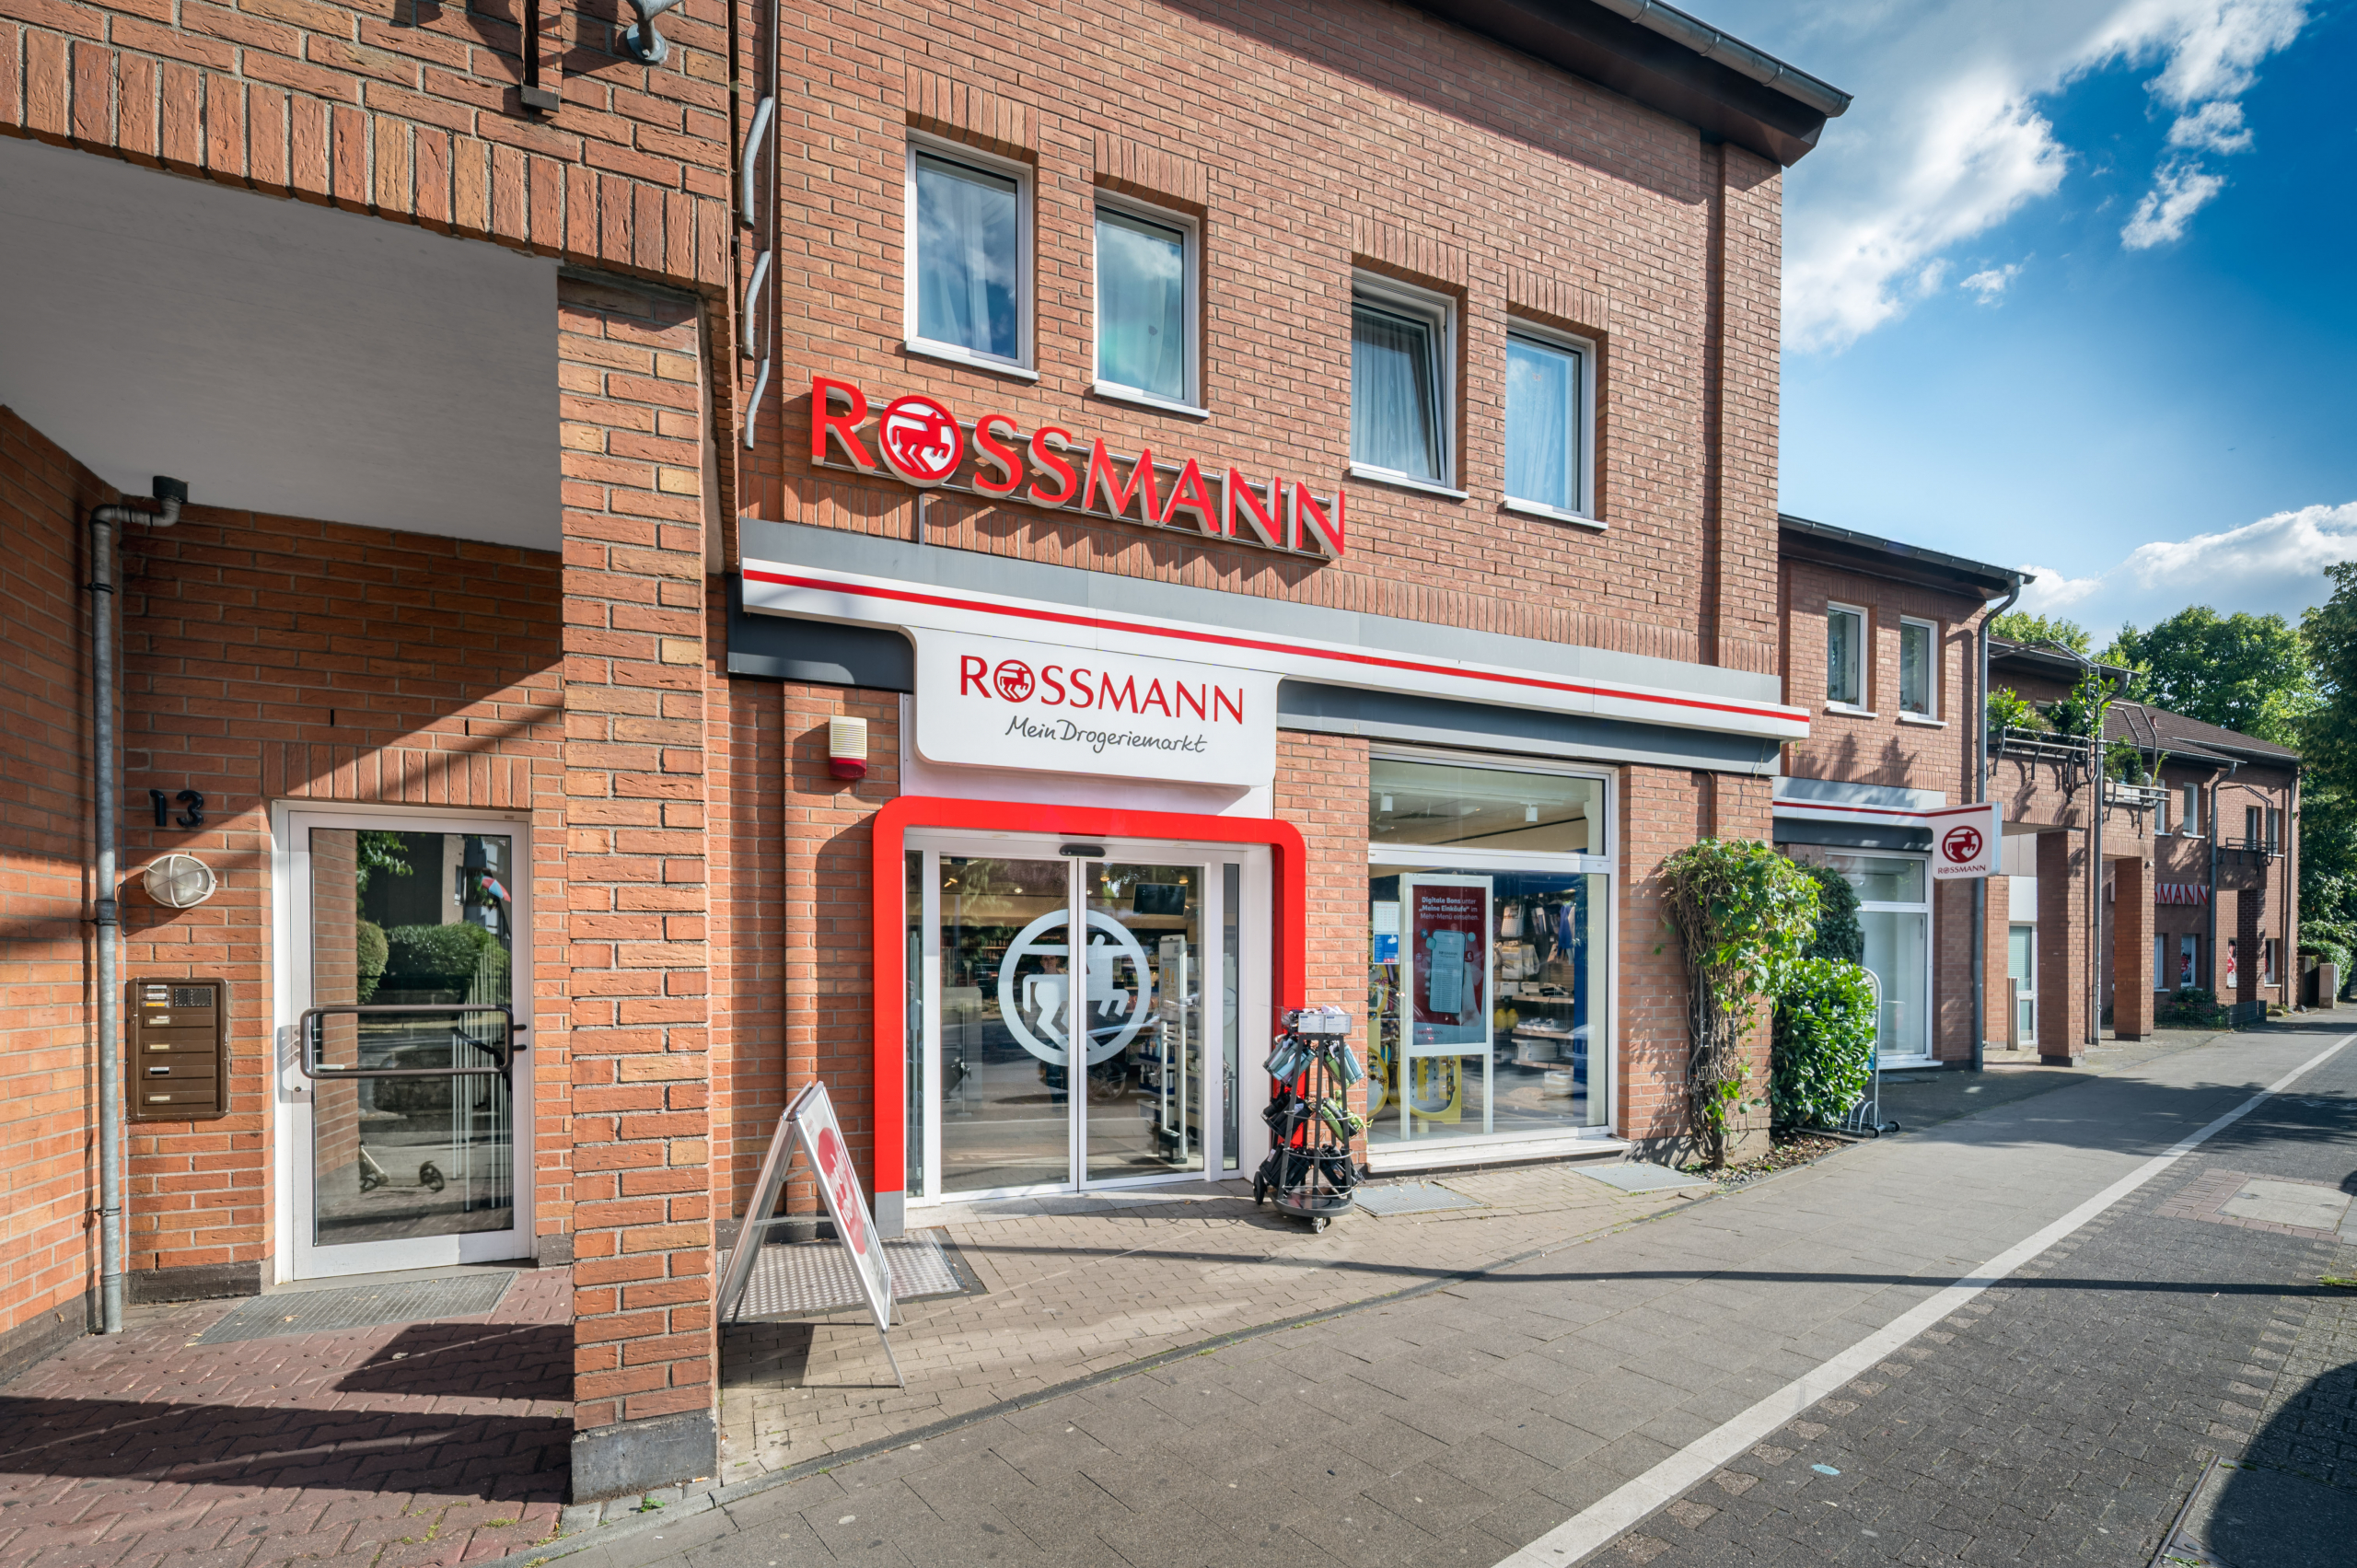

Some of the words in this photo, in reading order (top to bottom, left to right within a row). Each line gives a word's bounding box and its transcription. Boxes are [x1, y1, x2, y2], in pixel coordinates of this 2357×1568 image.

[812, 376, 1345, 559] ROSSMANN
[960, 655, 1243, 725] ROSSMANN
[1005, 715, 1056, 740] Mein
[1056, 719, 1207, 753] Drogeriemarkt
[149, 789, 204, 828] 13
[1937, 865, 1986, 874] ROSSMANN
